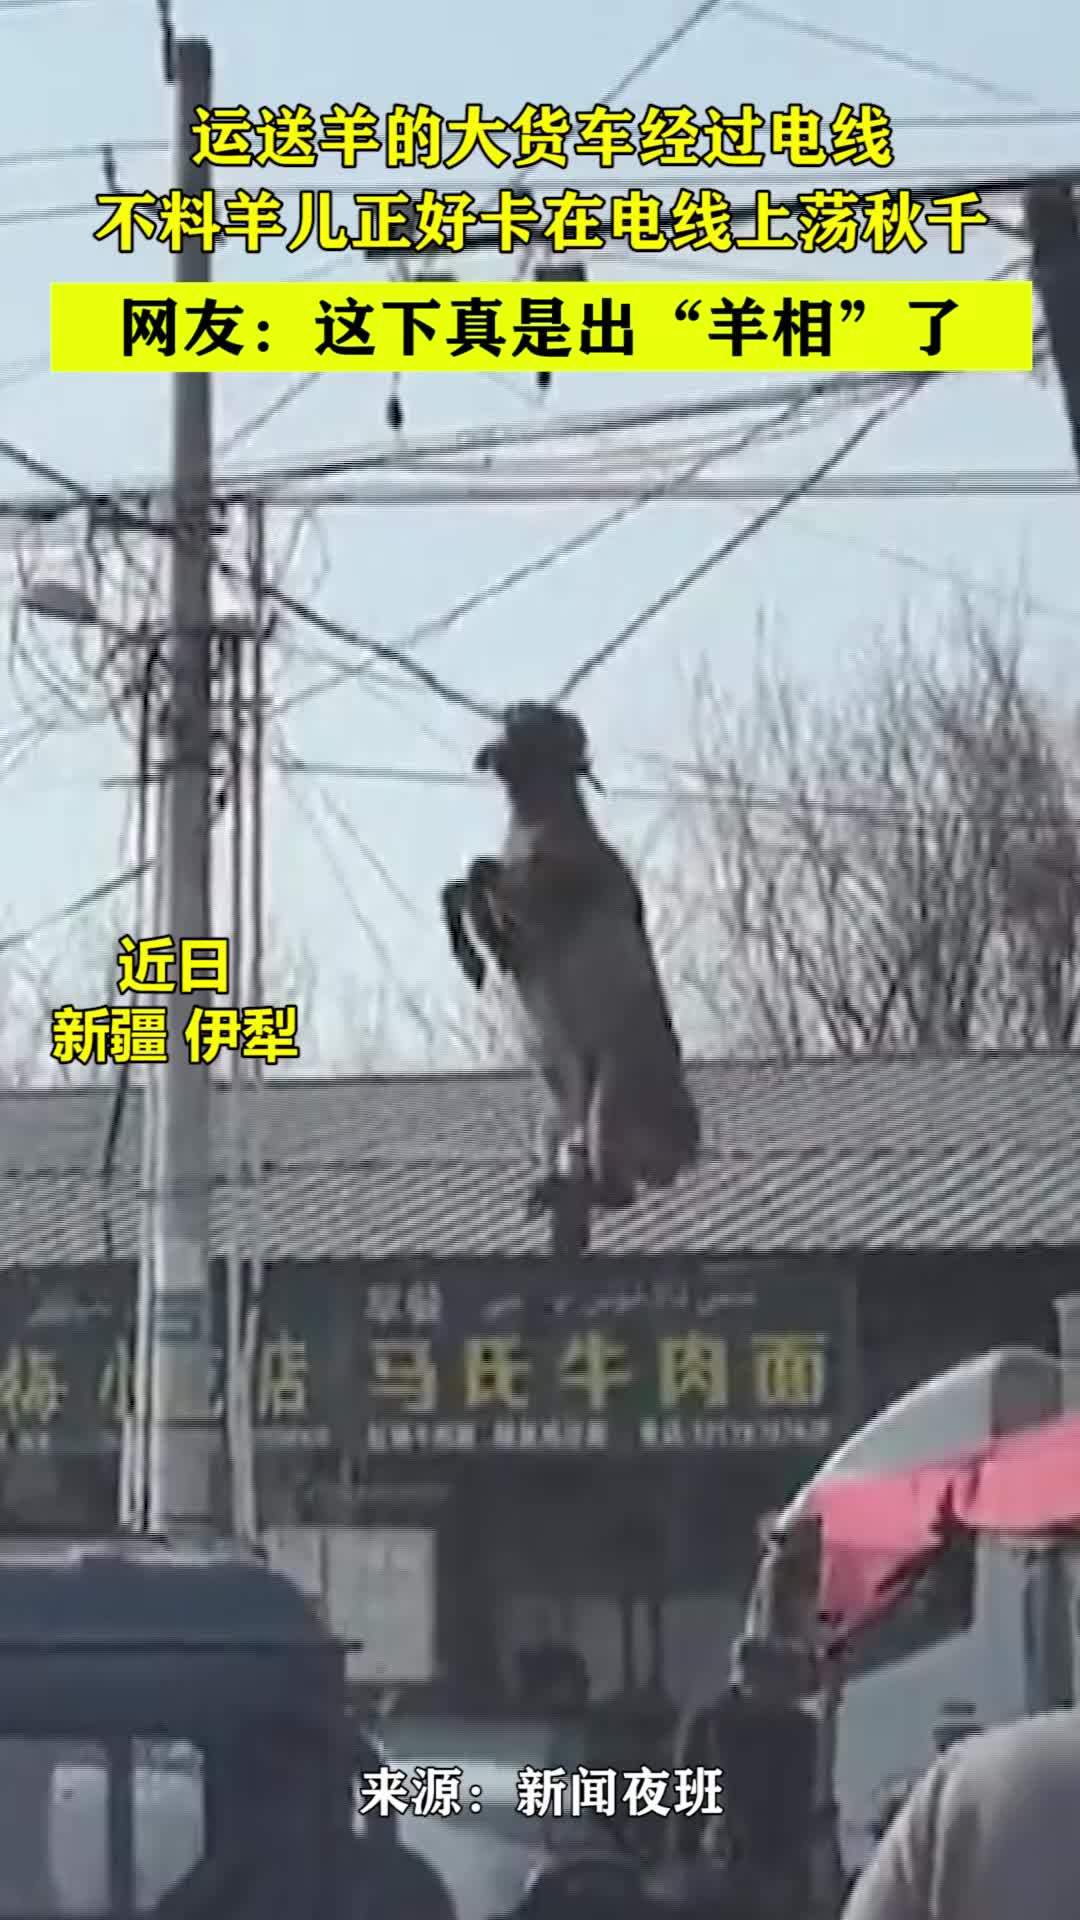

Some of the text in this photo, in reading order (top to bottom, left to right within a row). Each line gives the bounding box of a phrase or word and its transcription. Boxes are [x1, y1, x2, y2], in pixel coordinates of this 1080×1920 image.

[368, 1329, 830, 1411] 马氏牛肉面
